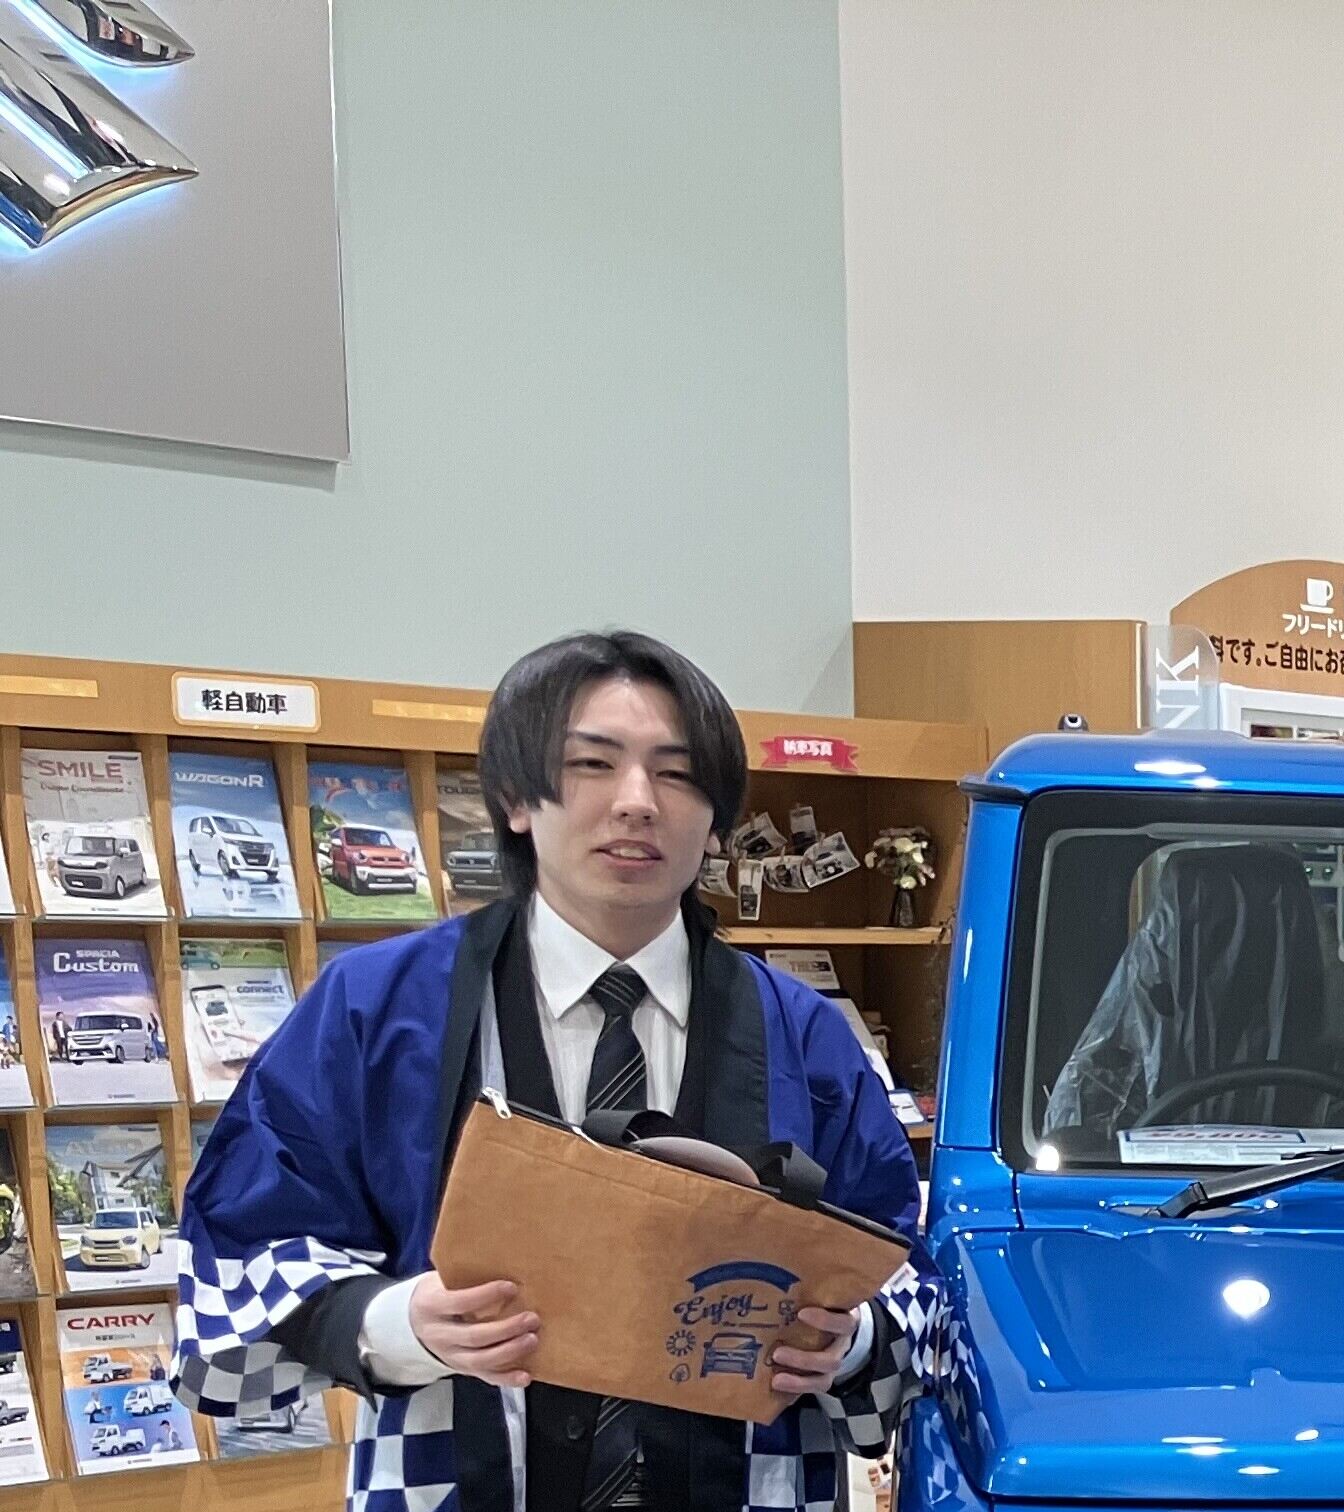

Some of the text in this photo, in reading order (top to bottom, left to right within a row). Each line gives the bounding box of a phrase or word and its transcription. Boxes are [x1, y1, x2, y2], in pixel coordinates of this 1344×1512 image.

[202, 689, 288, 715] 軽自動車
[38, 760, 122, 778] SMILE
[53, 952, 139, 973] Custom
[237, 985, 284, 994] connect
[673, 1293, 768, 1325] Enjoy
[67, 1313, 155, 1330] CARRY
